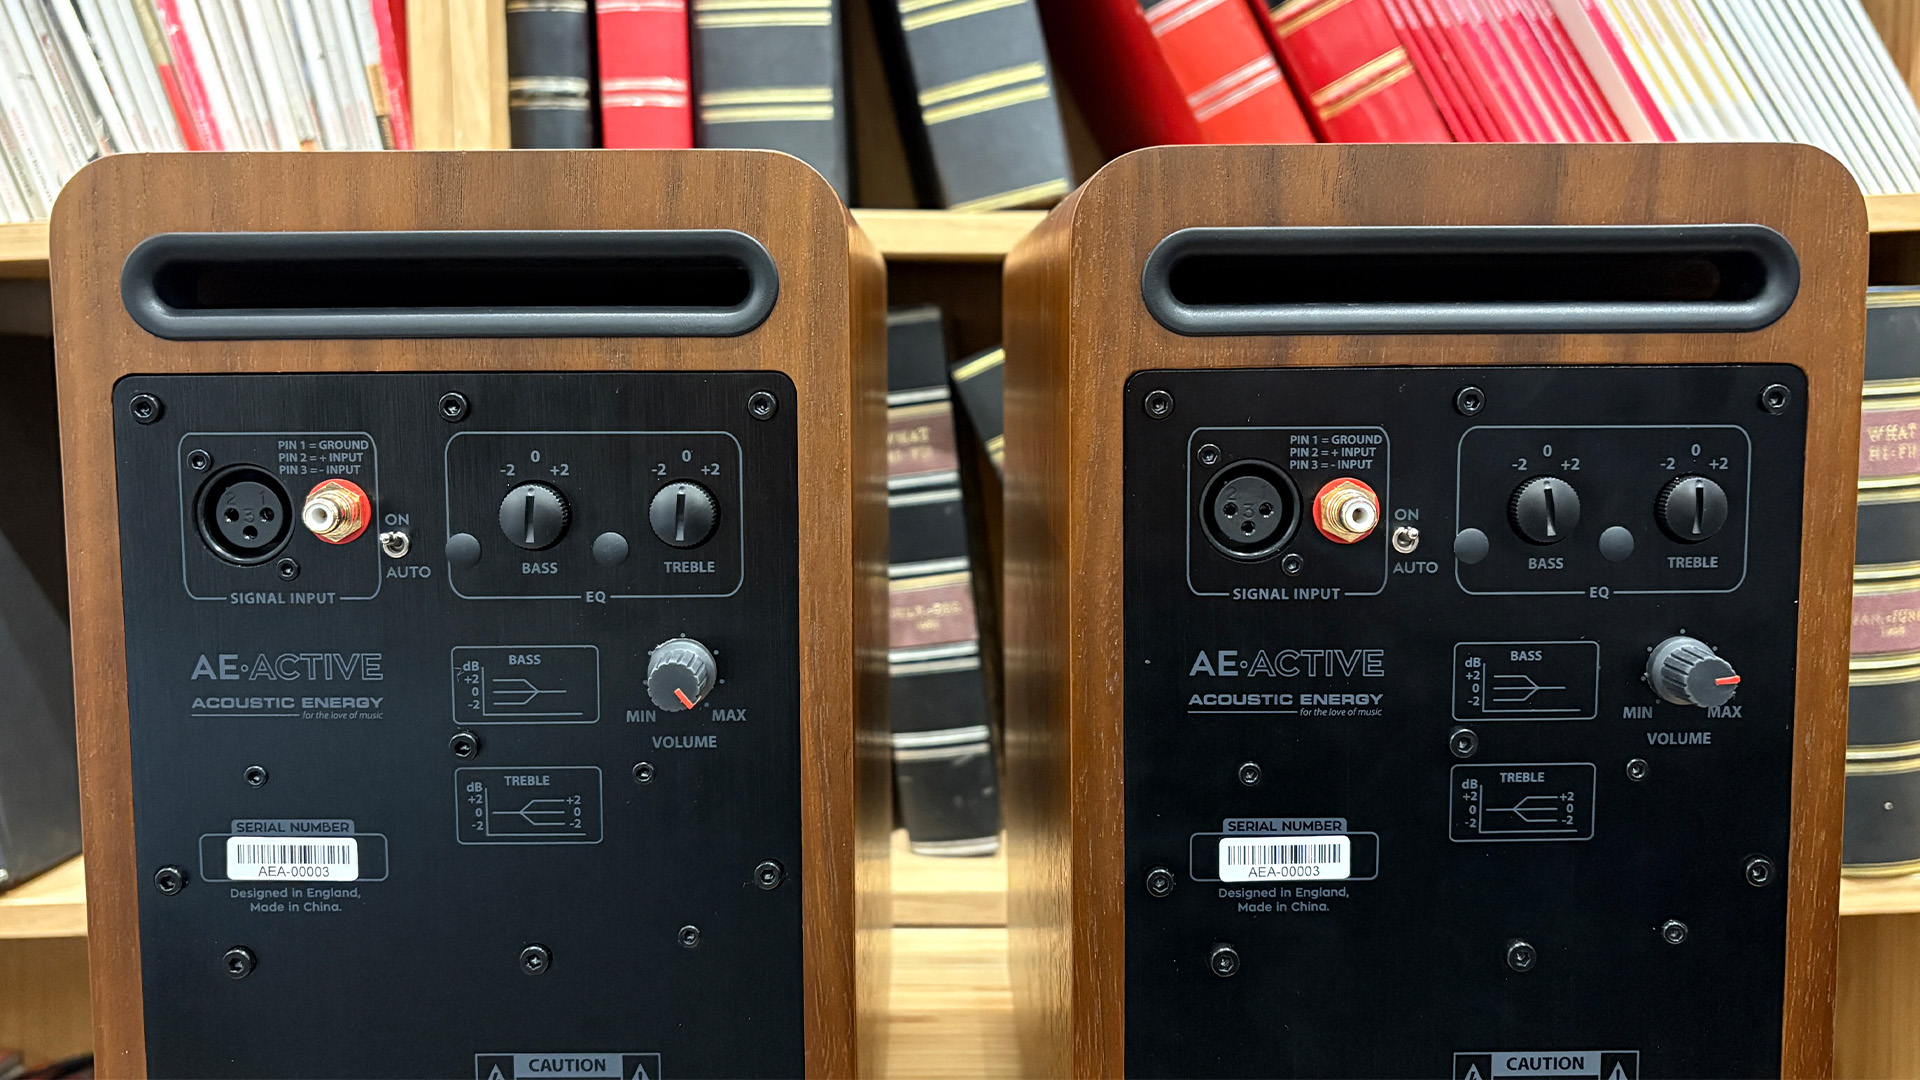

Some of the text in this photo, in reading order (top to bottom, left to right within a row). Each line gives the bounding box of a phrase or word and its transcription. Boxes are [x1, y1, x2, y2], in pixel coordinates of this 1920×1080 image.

[278, 441, 297, 450] PIN
[300, 441, 305, 450] 1
[319, 440, 368, 450] GROUND
[1290, 435, 1309, 444] PIN
[1312, 435, 1317, 444] 1
[1332, 435, 1382, 444] GROUND
[1290, 448, 1309, 457] PIN
[1312, 448, 1318, 457] 2
[1342, 447, 1376, 456] INPUT
[1543, 445, 1552, 457] 0
[1692, 444, 1700, 456] 0
[279, 453, 297, 462] PIN
[300, 453, 307, 462] 2
[329, 453, 363, 462] INPUT
[531, 451, 540, 462] 0
[682, 450, 691, 462] 0
[1290, 460, 1308, 469] PIN
[1312, 460, 1318, 469] 3
[1338, 460, 1373, 469] INPUT
[1512, 458, 1527, 470] -2
[1561, 458, 1580, 470] +2
[1660, 458, 1675, 469] -2
[1709, 457, 1728, 469] +2
[279, 465, 298, 474] PIN
[301, 465, 307, 474] 3
[327, 465, 361, 474] INPUT
[500, 464, 515, 476] -2
[550, 464, 569, 475] +2
[652, 464, 666, 475] -2
[701, 463, 720, 475] +2
[226, 492, 237, 505] 2
[259, 492, 265, 505] 1
[1226, 487, 1237, 499] 2
[243, 508, 254, 523] 3
[1243, 503, 1254, 518] 3
[1395, 509, 1418, 520] ON
[385, 514, 409, 525] ON
[523, 562, 557, 574] BASS
[664, 561, 715, 573] TREBLE
[1393, 562, 1438, 573] AUTO
[1529, 558, 1563, 569] BASS
[1667, 557, 1718, 568] TREBLE
[386, 566, 431, 578] AUTO
[231, 592, 335, 604] SIGNAL INPUT
[586, 591, 605, 603] EQ
[1233, 588, 1340, 599] SIGNAL INPUT
[1590, 587, 1609, 599] EQ
[509, 655, 541, 665] BASS
[1511, 651, 1542, 661] BASS
[463, 661, 479, 671] dB
[1465, 657, 1481, 667] dB
[464, 674, 479, 683] +2
[1466, 671, 1480, 680] +2
[472, 687, 479, 696] 0
[1472, 683, 1479, 693] 0
[192, 697, 383, 708] ACOUSTIC ENERGY
[468, 700, 480, 709] -2
[1189, 694, 1383, 705] ACOUSTIC ENERGY
[1468, 696, 1479, 706] -2
[302, 711, 383, 720] for the love of music
[627, 710, 655, 722] MIN
[712, 709, 746, 721] MAX
[1300, 708, 1382, 716] for the love of music
[1623, 707, 1652, 719] MIN
[1708, 706, 1742, 718] MAX
[652, 736, 717, 748] VOLUME
[1647, 732, 1711, 745] VOLUME
[504, 776, 550, 786] TREBLE
[1500, 772, 1544, 782] TREBLE
[467, 782, 483, 792] dB
[1462, 779, 1478, 789] dB
[468, 794, 483, 804] +2
[566, 795, 581, 804] +2
[1463, 791, 1477, 800] +2
[1560, 792, 1574, 801] +2
[475, 808, 482, 817] 0
[574, 807, 581, 816] 0
[1469, 805, 1476, 814] 0
[1567, 804, 1573, 813] 0
[570, 819, 581, 828] -2
[1465, 818, 1476, 827] -2
[1562, 815, 1573, 824] -2
[237, 823, 349, 832] SERIAL NUMBER
[472, 821, 483, 830] -2
[1228, 821, 1342, 831] SERIAL NUMBER
[258, 866, 329, 877] AEA-00003
[1248, 866, 1320, 877] AEA-00003
[231, 888, 361, 900] Designed in England,
[1219, 887, 1349, 899] Designed in England,
[251, 901, 342, 912] Made in China.
[1238, 901, 1329, 912] Made in China.
[529, 1059, 606, 1072] CAUTION
[1506, 1057, 1584, 1070] CAUTION
